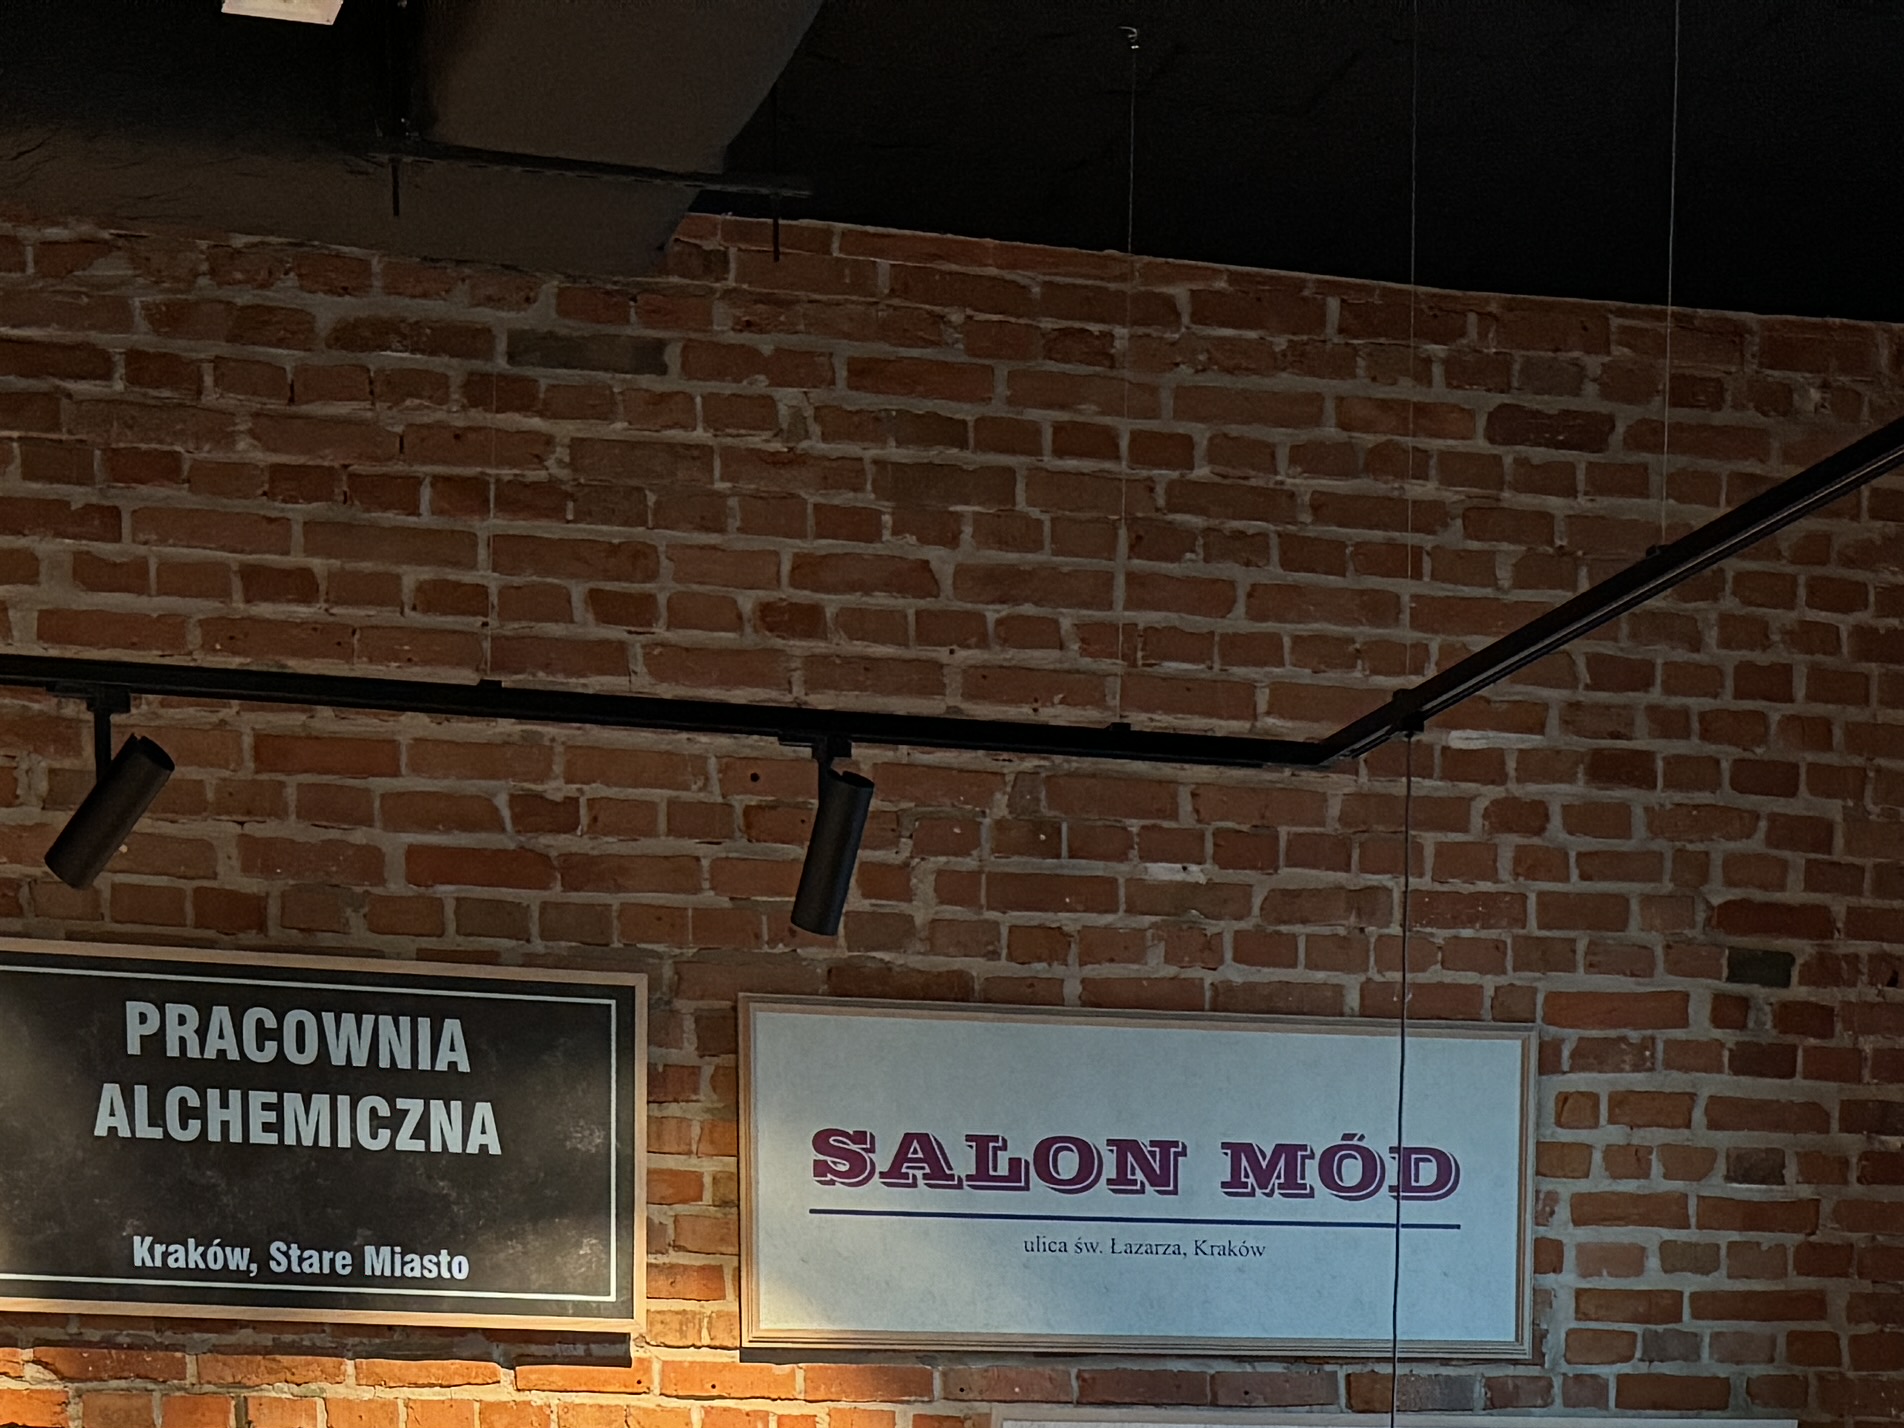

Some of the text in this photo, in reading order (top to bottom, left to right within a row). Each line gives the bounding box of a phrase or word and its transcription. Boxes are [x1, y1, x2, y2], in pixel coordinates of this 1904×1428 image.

[124, 1000, 471, 1074] PRACOWNIA
[93, 1082, 503, 1156] ALCHEMICZNA
[810, 1127, 1462, 1202] SALON MÓD
[132, 1235, 471, 1281] Kraków, Stare Miasto
[1022, 1235, 1267, 1260] ulica św. Łazarza, Kraków
